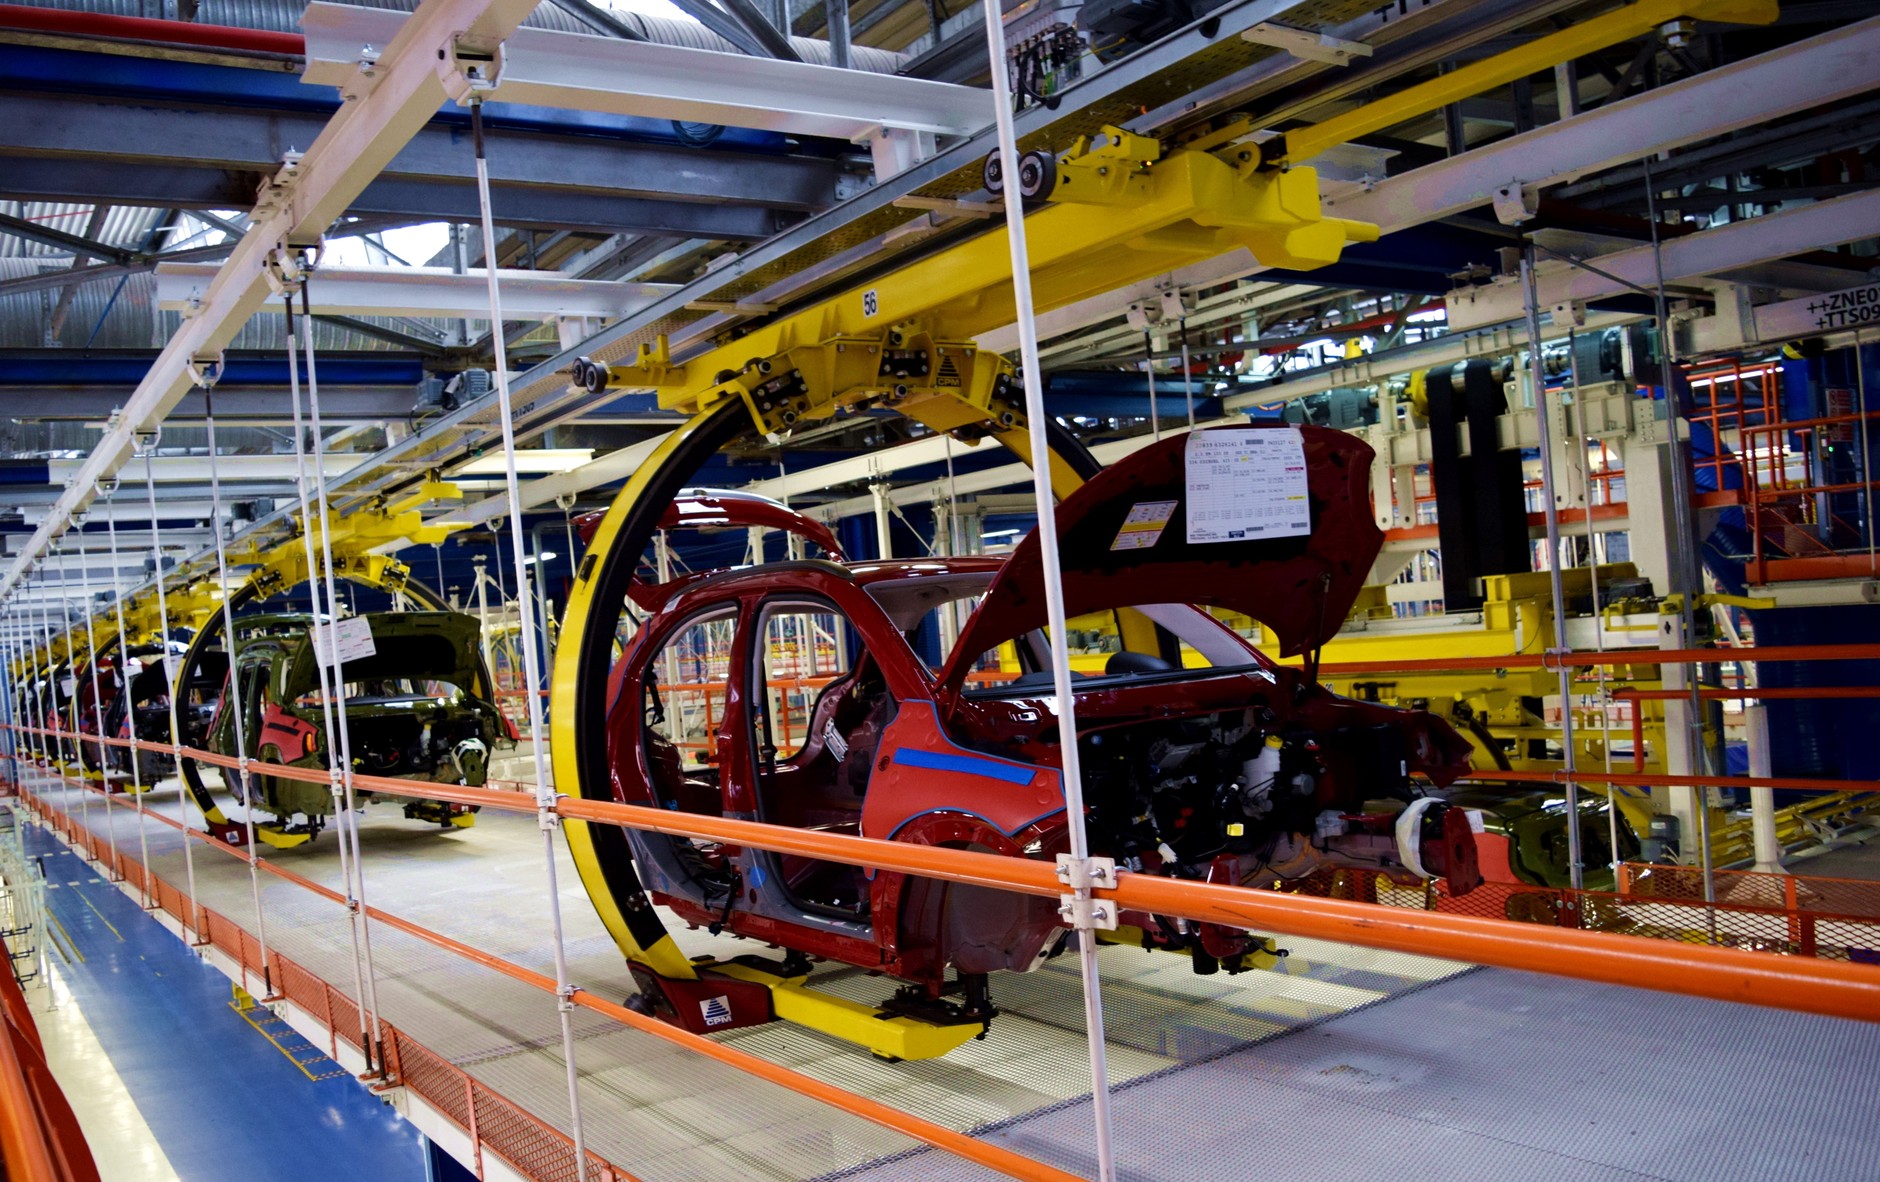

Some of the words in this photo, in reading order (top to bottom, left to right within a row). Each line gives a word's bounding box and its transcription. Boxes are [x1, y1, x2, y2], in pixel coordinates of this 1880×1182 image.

[864, 291, 877, 316] 56
[1806, 287, 1880, 314] ++ZNE0
[937, 378, 961, 387] CPM
[706, 1015, 732, 1026] CPM
